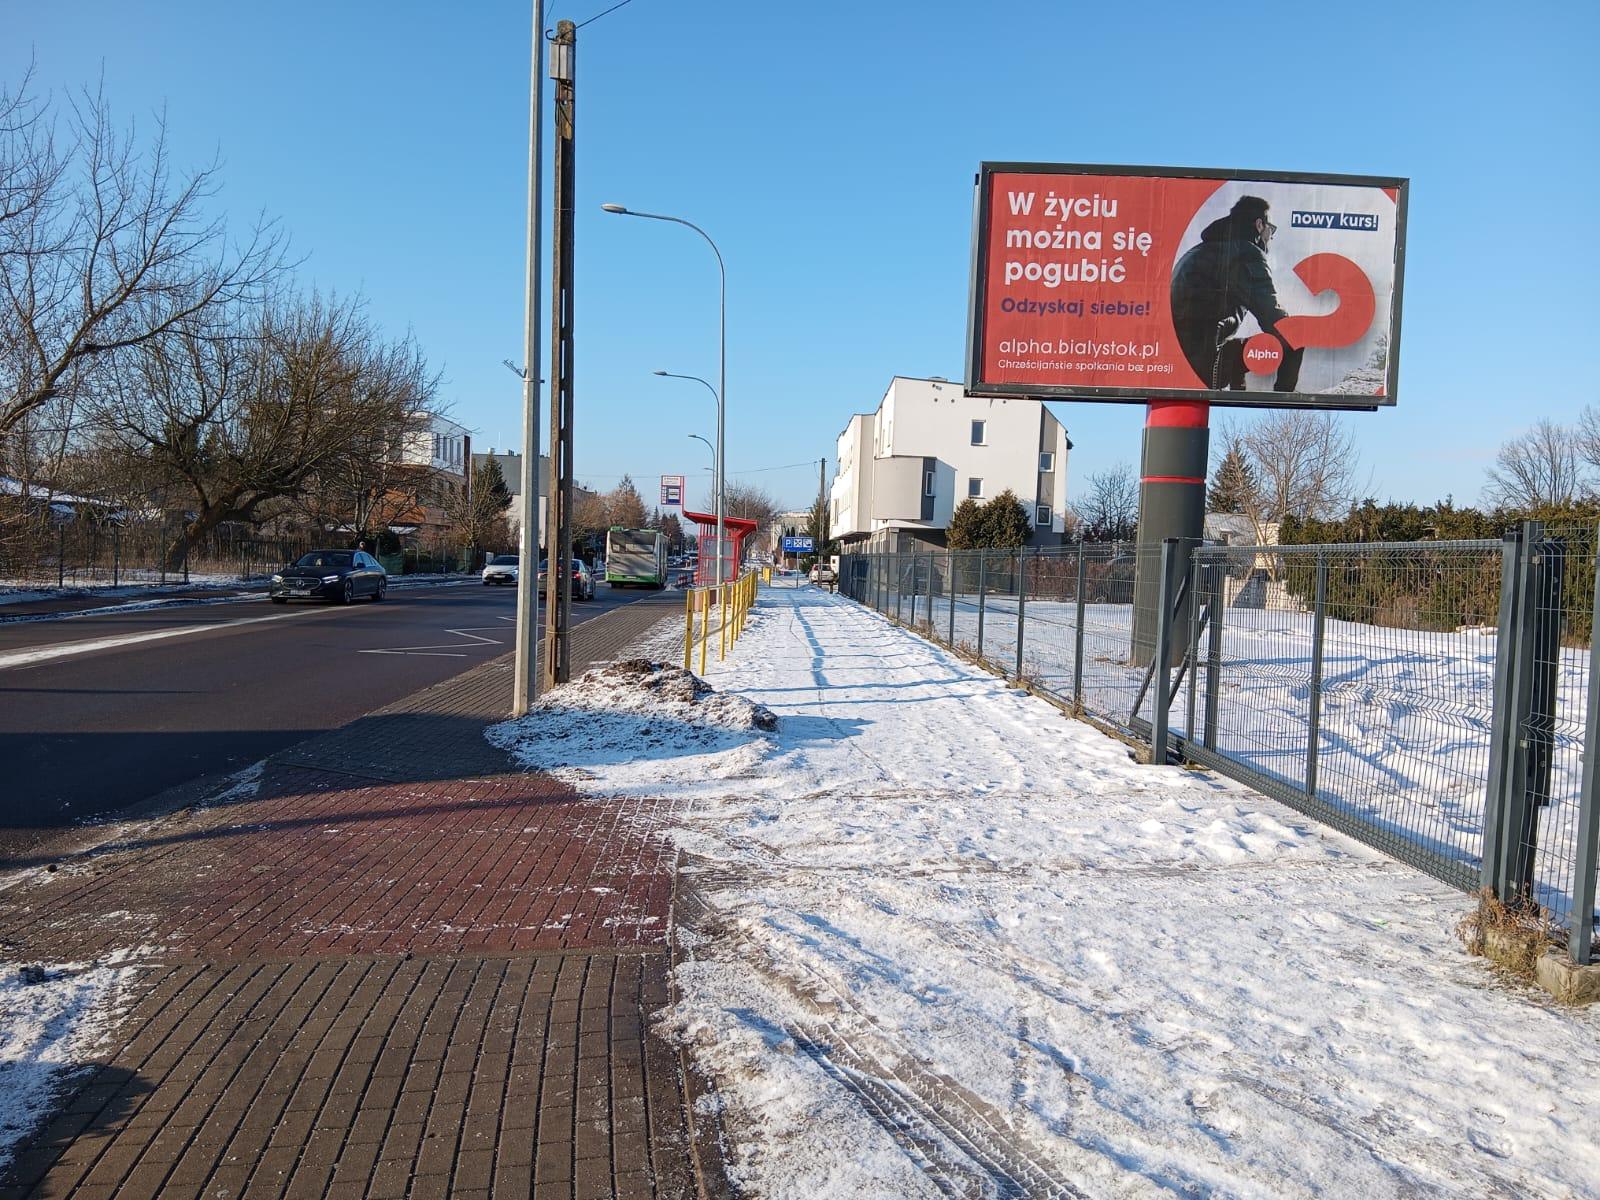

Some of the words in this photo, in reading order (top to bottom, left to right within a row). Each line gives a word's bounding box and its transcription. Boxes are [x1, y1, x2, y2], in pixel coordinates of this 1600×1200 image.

[1007, 191, 1035, 215] W
[1044, 191, 1118, 222] życiu
[1292, 213, 1335, 228] nowy
[1340, 212, 1377, 228] kurs!
[1006, 224, 1102, 250] można
[1112, 226, 1153, 257] się
[1004, 256, 1127, 288] pogubić
[1001, 297, 1084, 318] Odzyskaj
[1090, 300, 1151, 316] siebie!
[999, 338, 1159, 359] alpha.bialystok.pl
[1247, 349, 1279, 361] Alpha
[998, 359, 1073, 371] Chrześcijańskie
[1127, 362, 1144, 372] bez
[1147, 363, 1173, 374] presji
